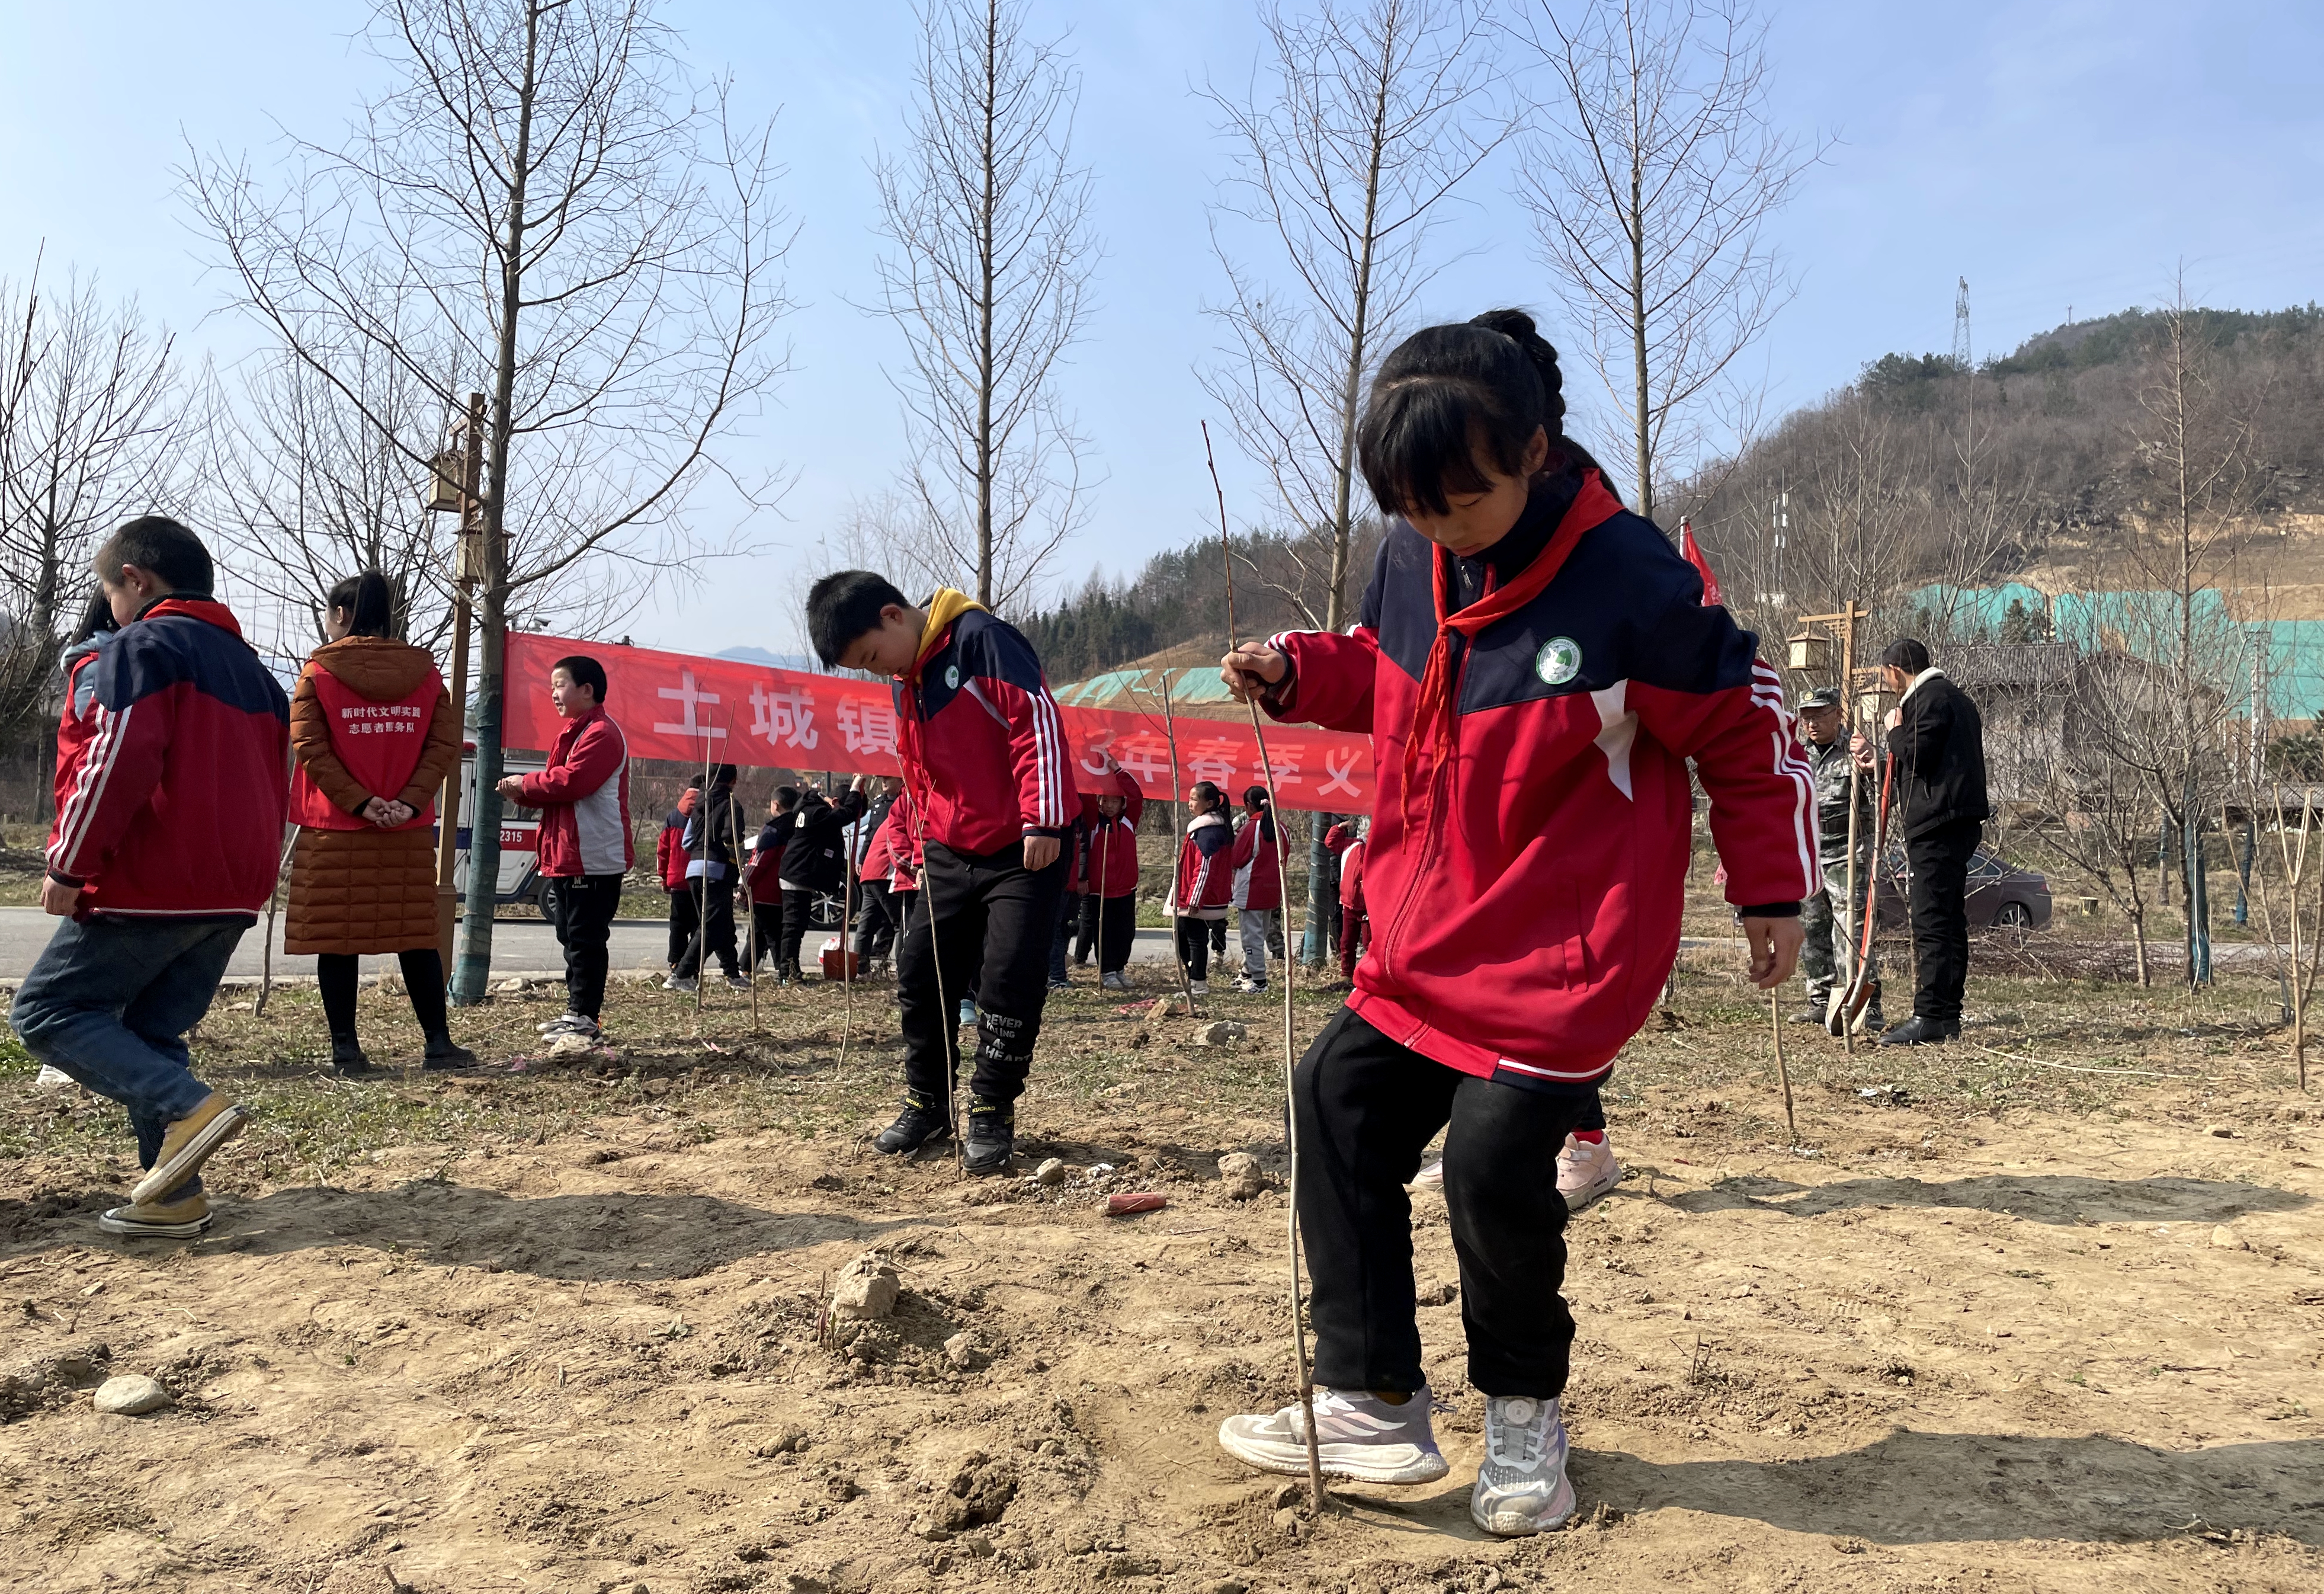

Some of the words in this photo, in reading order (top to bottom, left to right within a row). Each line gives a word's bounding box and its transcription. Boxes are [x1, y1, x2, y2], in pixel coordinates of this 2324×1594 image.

[653, 671, 897, 756] 土城镇
[500, 830, 522, 843] 2315
